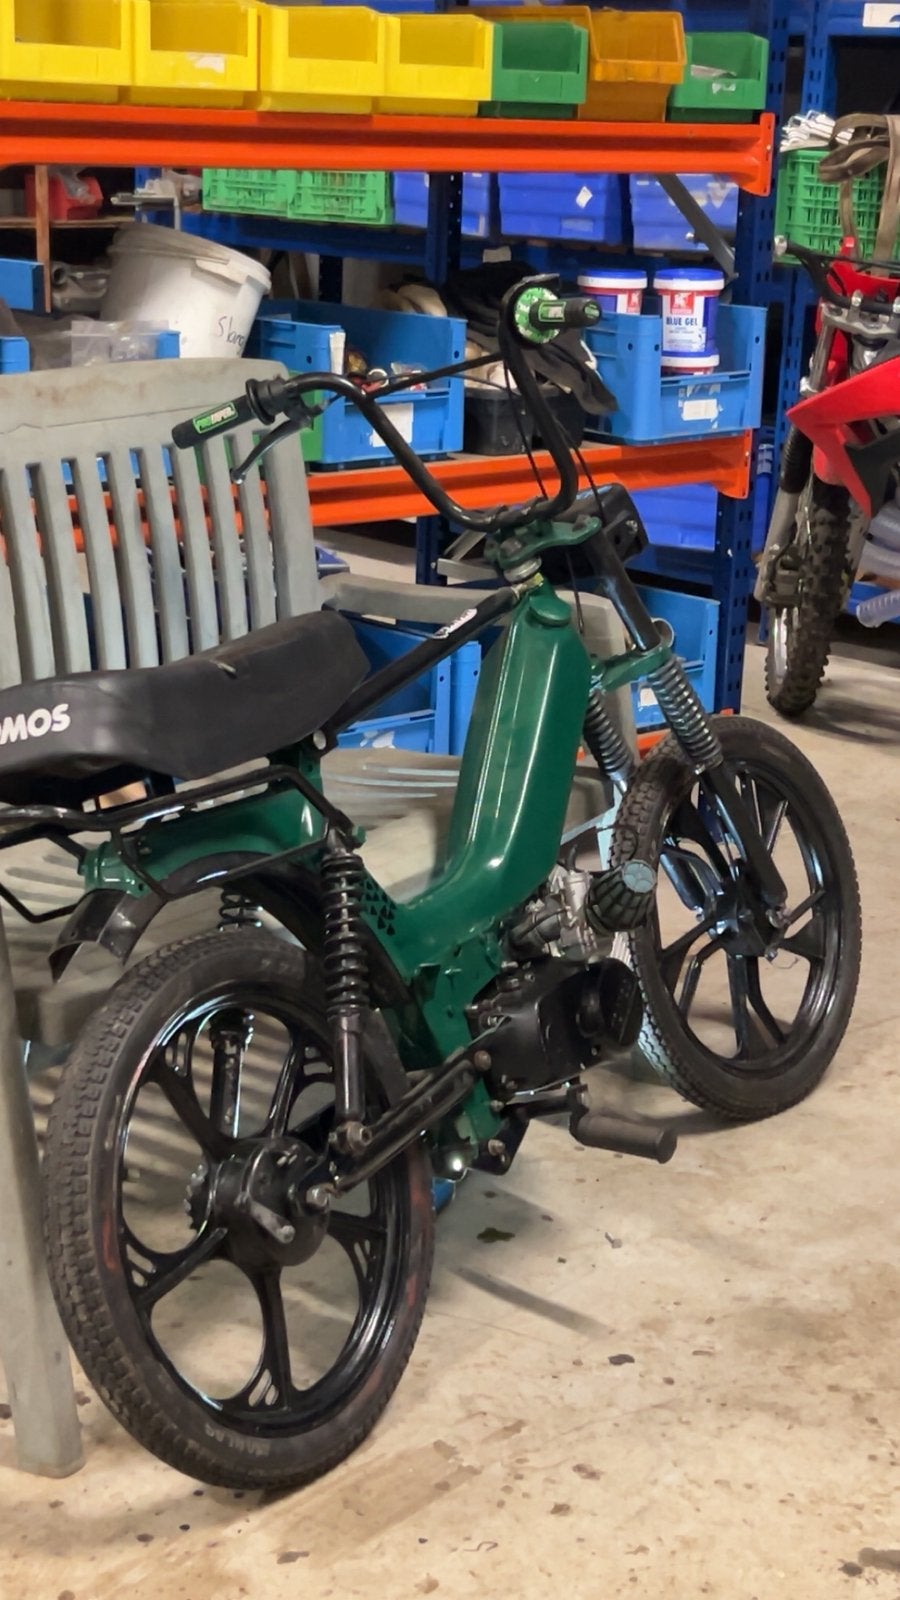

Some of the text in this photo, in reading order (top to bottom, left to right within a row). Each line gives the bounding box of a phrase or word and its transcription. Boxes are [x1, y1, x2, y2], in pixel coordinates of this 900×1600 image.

[665, 316, 698, 326] BLUE GEL
[0, 703, 71, 746] MOS
